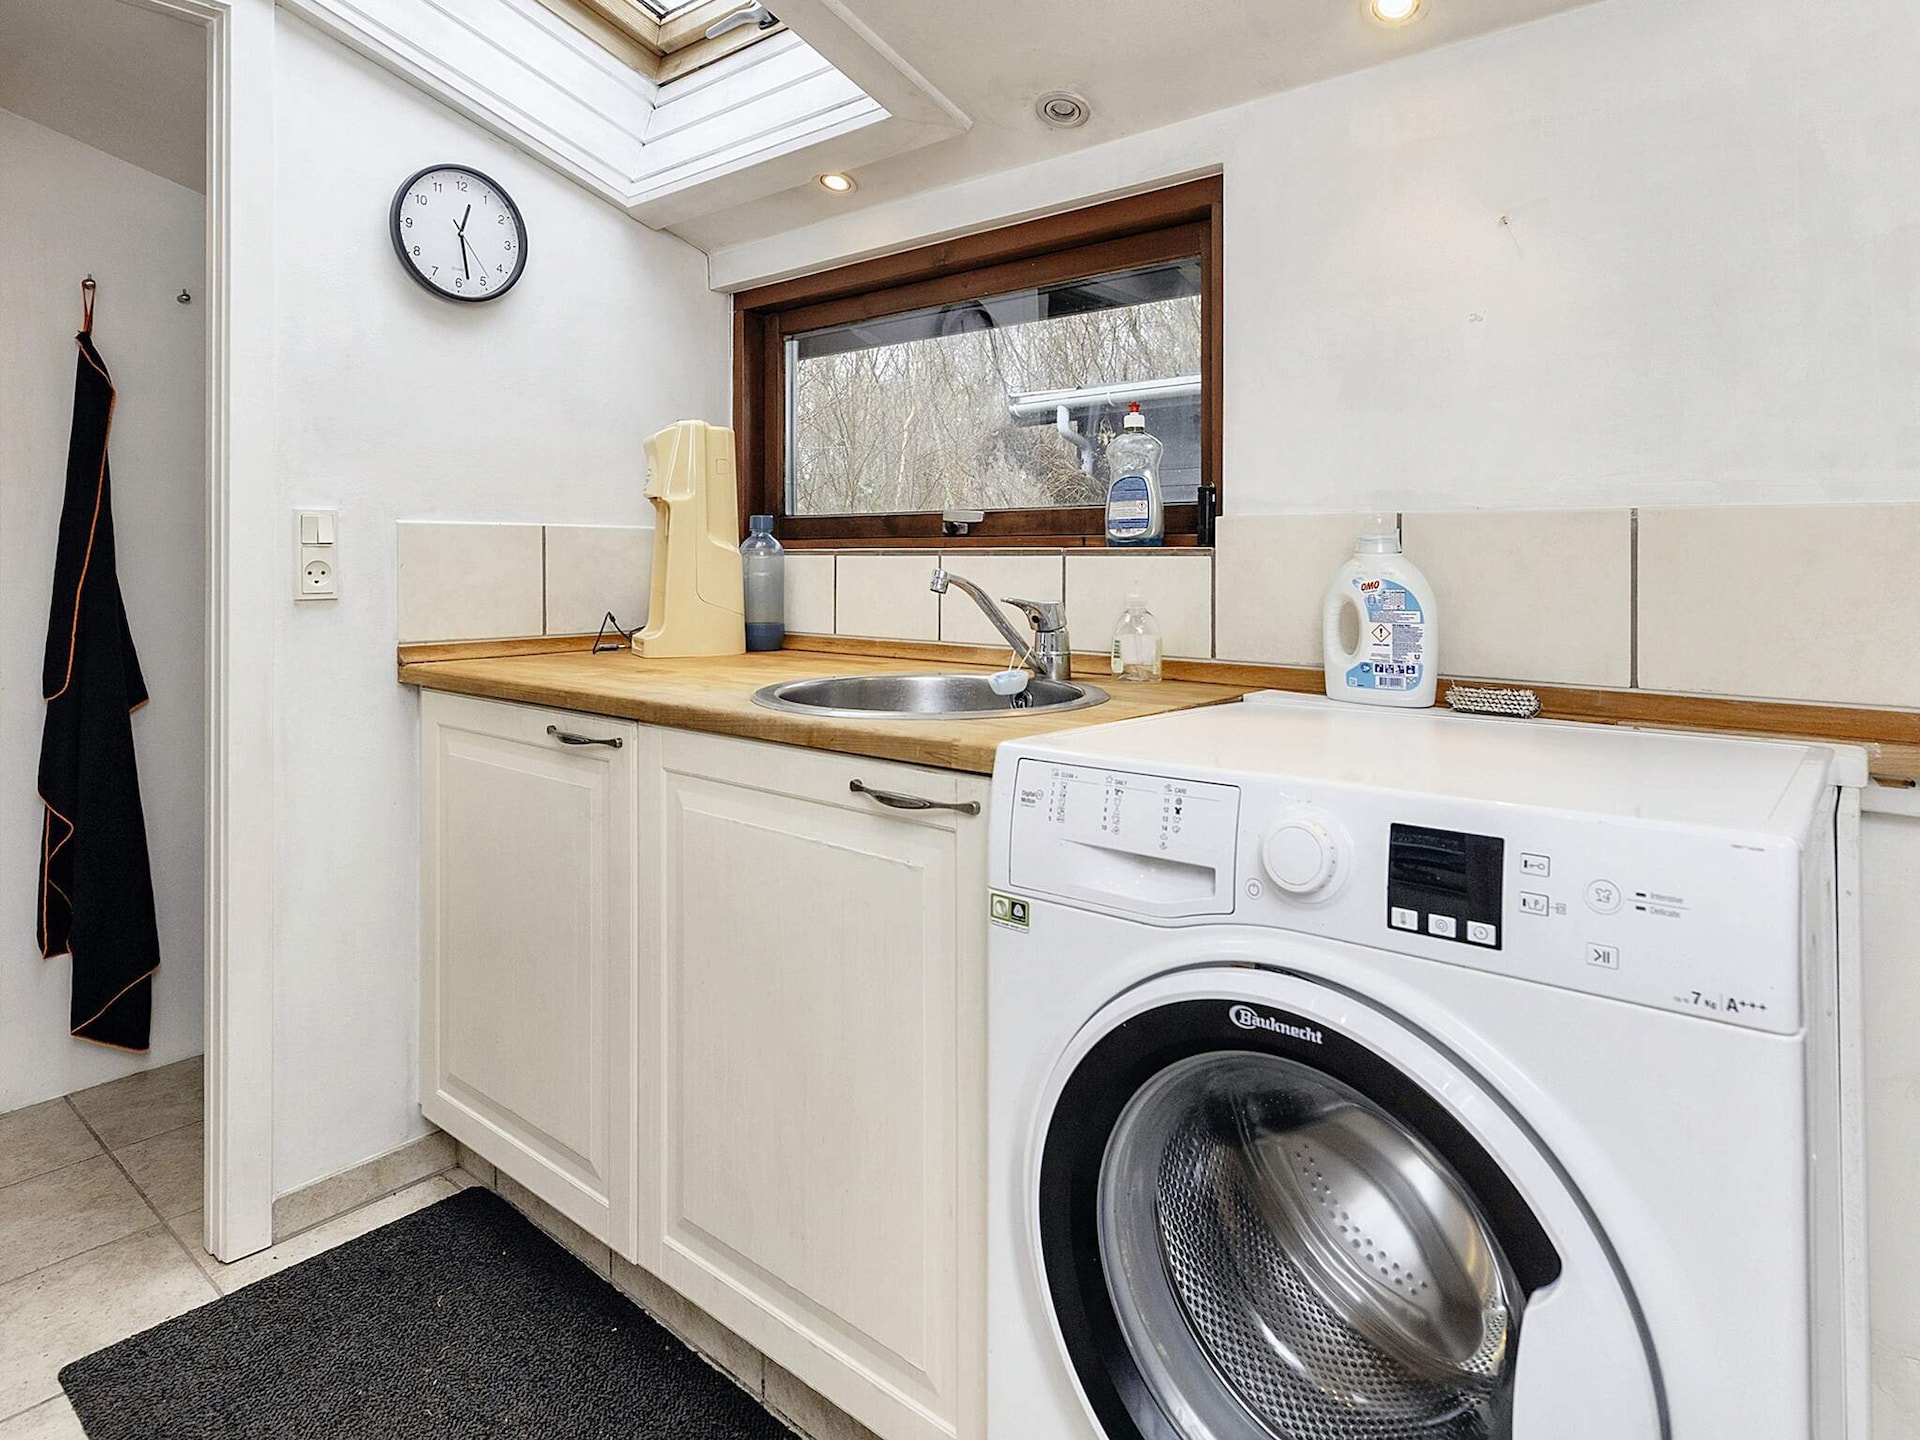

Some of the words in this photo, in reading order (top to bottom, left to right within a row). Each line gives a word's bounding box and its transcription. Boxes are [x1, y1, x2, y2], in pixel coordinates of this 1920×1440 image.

[433, 182, 442, 193] 11
[456, 181, 468, 192] 12
[415, 194, 428, 205] 10
[483, 195, 488, 205] 1
[405, 217, 413, 228] 9
[497, 214, 505, 225] 2
[413, 245, 421, 256] 8
[504, 240, 511, 251] 3
[431, 265, 439, 276] 7
[496, 264, 503, 273] 4
[455, 277, 463, 288] 6
[479, 276, 487, 286] 5
[1361, 580, 1380, 591] OMO
[1021, 790, 1036, 798] Digital
[1650, 906, 1681, 919] Delicate
[1691, 991, 1701, 1005] 7
[1726, 998, 1768, 1013] A+++
[1229, 1005, 1323, 1045] Bauknecht
